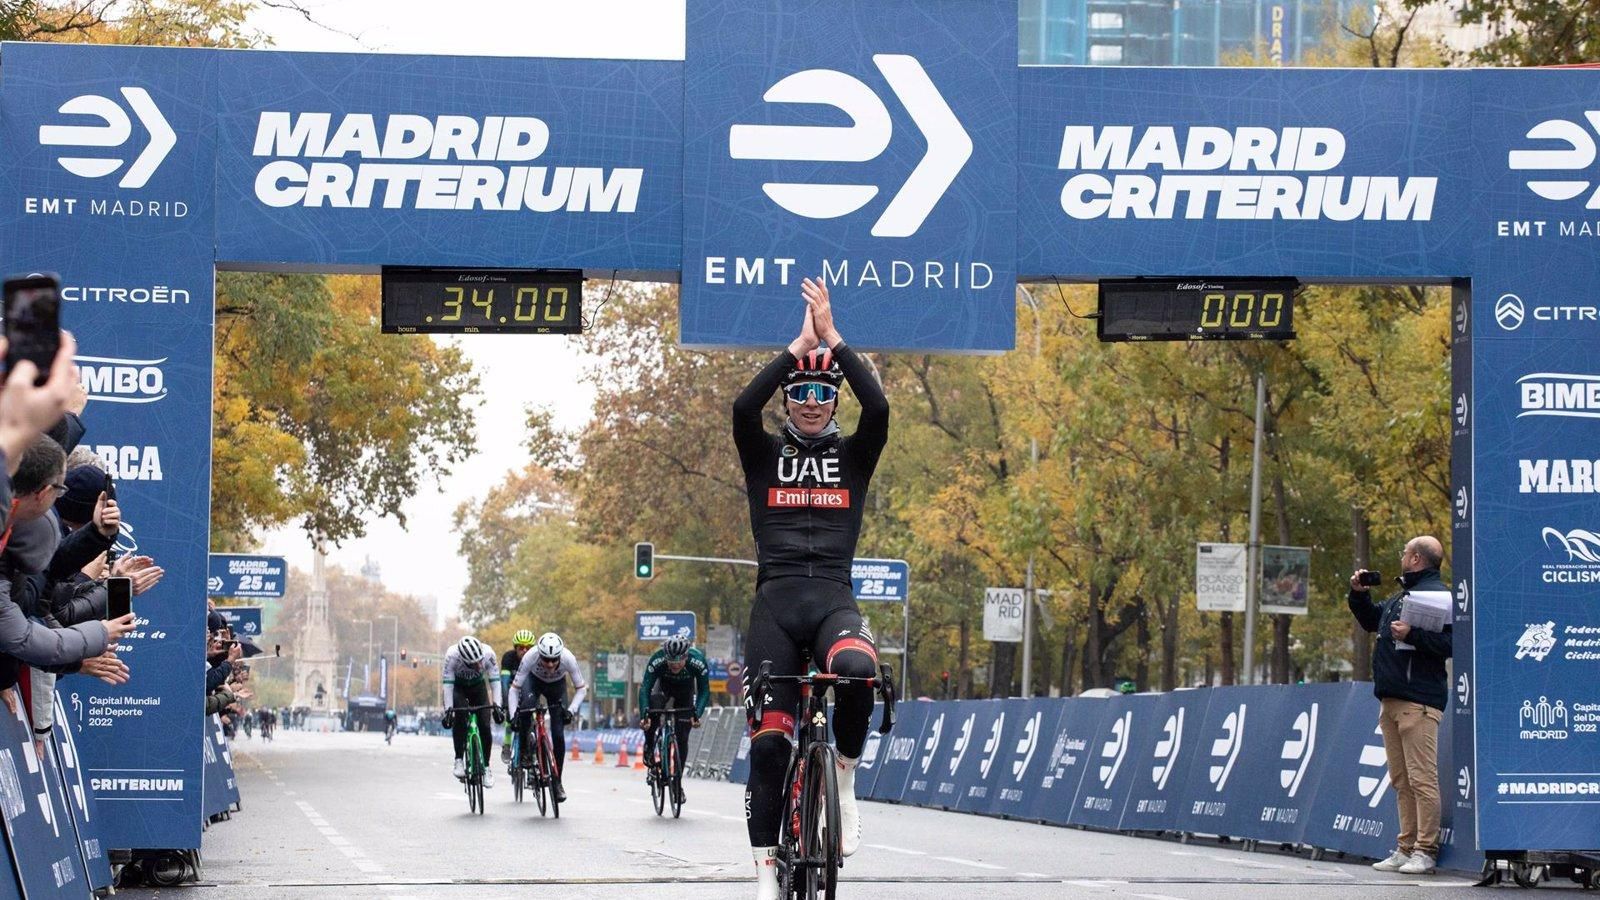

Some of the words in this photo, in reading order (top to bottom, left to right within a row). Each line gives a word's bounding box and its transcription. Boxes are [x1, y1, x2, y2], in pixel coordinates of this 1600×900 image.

[253, 112, 549, 161] MADRID
[1058, 126, 1345, 170] MADRID
[255, 161, 643, 212] CRITERIUM
[1061, 174, 1437, 220] CRITERIUM
[26, 198, 76, 214] EMT
[92, 200, 187, 217] MADRID
[1498, 222, 1546, 236] EMT
[1560, 222, 1600, 236] MA
[706, 257, 795, 284] EMT
[822, 259, 993, 290] MADRID
[61, 286, 189, 303] CITROËN
[1533, 306, 1598, 321] CITR
[80, 366, 164, 394] MBO
[1521, 383, 1600, 409] BIMB
[96, 445, 162, 481] RCA
[777, 456, 841, 482] UAE
[775, 489, 843, 506] Emirates
[229, 560, 269, 568] MADRID
[229, 567, 280, 575] CRITERIUM
[239, 575, 263, 590] 25
[264, 582, 276, 590] M
[1199, 575, 1243, 584] PICASSO
[1542, 570, 1600, 583] CICLISM
[860, 579, 885, 595] 25
[885, 586, 897, 595] M
[986, 593, 1022, 605] MAD
[999, 606, 1021, 618] RID
[150, 630, 168, 639] de
[643, 626, 660, 636] 50
[1564, 638, 1600, 647] Madri
[89, 696, 122, 706] Capital
[124, 697, 161, 706] Mundial
[88, 707, 103, 716] del
[105, 708, 143, 718] Deporte
[1573, 713, 1587, 721] del
[88, 718, 113, 727] 2022
[1573, 724, 1597, 732] 2022
[1520, 730, 1568, 739] MADRID
[90, 778, 184, 791] CRITERIUM
[744, 791, 752, 820] UAE
[1261, 807, 1277, 822] EMT
[1275, 808, 1299, 824] MADRID
[1332, 813, 1352, 831] EMT
[1350, 817, 1384, 838] MADRID
